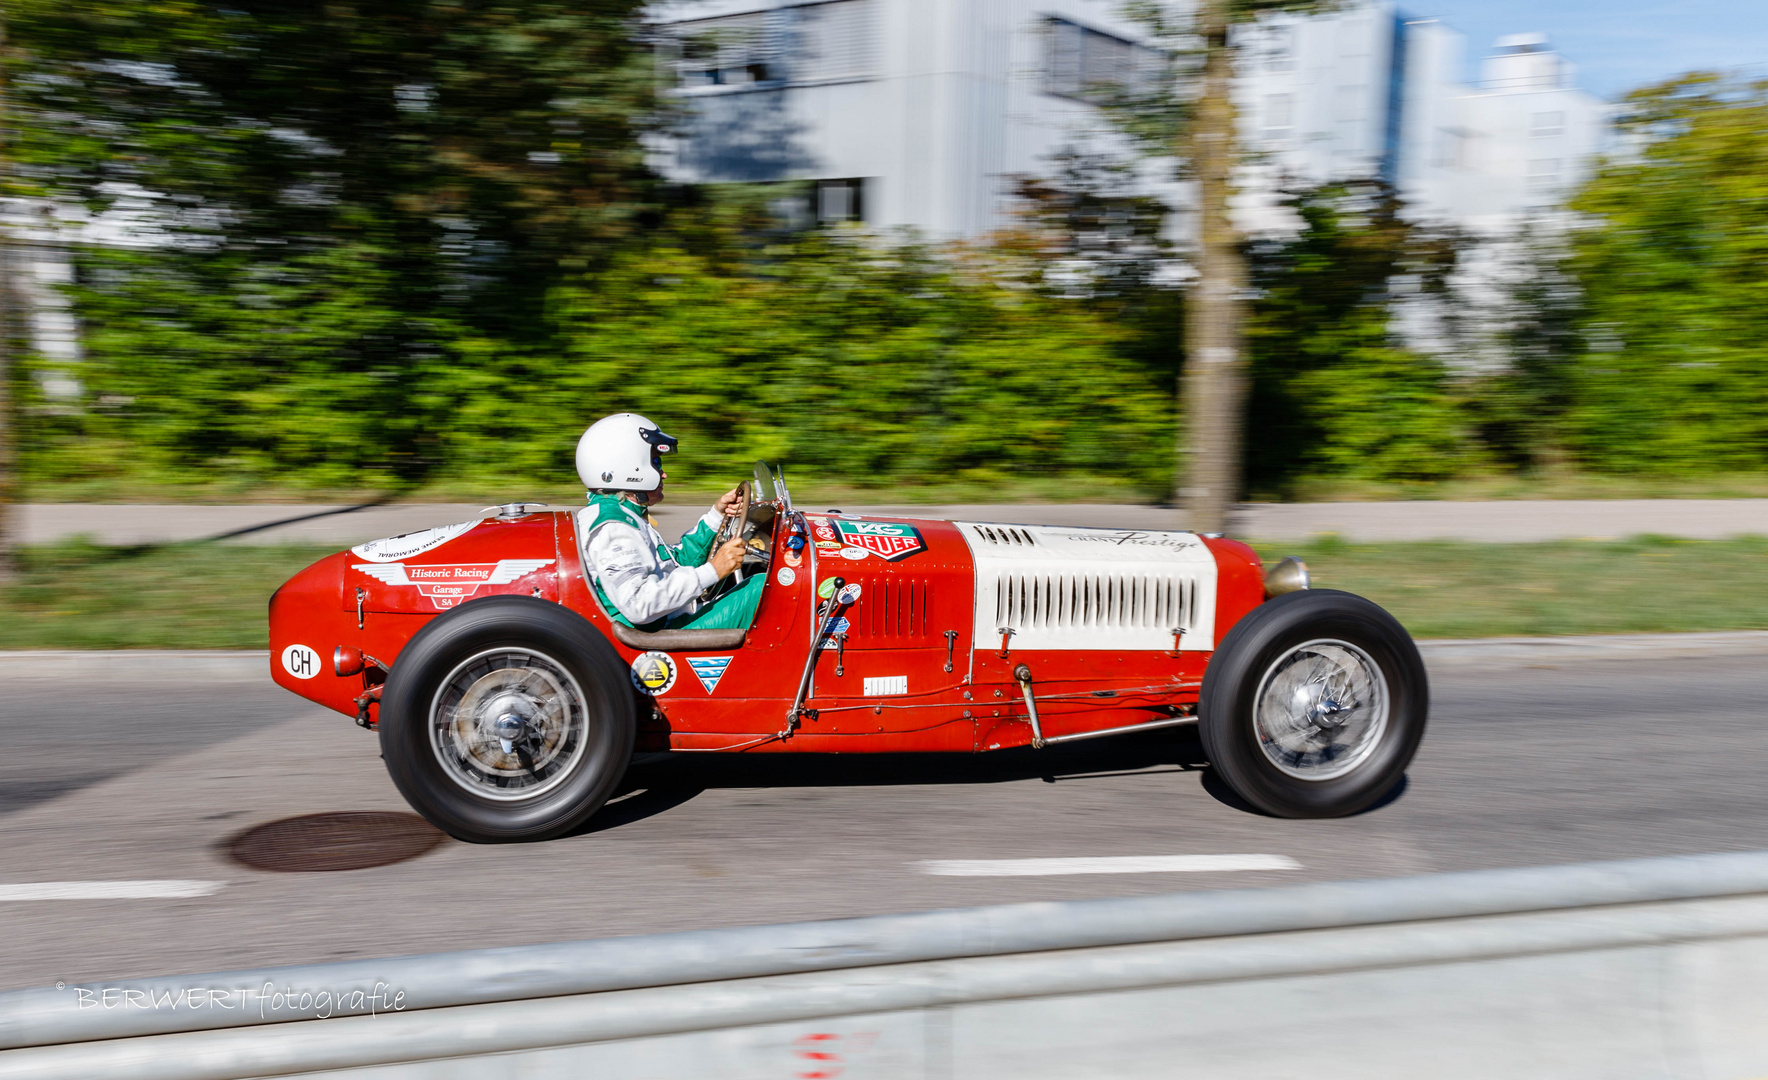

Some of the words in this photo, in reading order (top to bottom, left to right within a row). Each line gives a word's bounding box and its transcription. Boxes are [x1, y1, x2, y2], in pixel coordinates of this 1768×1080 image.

[848, 522, 904, 535] TAG
[850, 534, 917, 554] HEUER
[1115, 531, 1199, 552] Prestige
[378, 546, 420, 558] MEMORIAL
[411, 568, 451, 579] Historic
[454, 567, 489, 579] Racing
[432, 585, 463, 595] Garage
[441, 598, 453, 606] SA
[290, 649, 312, 675] CH
